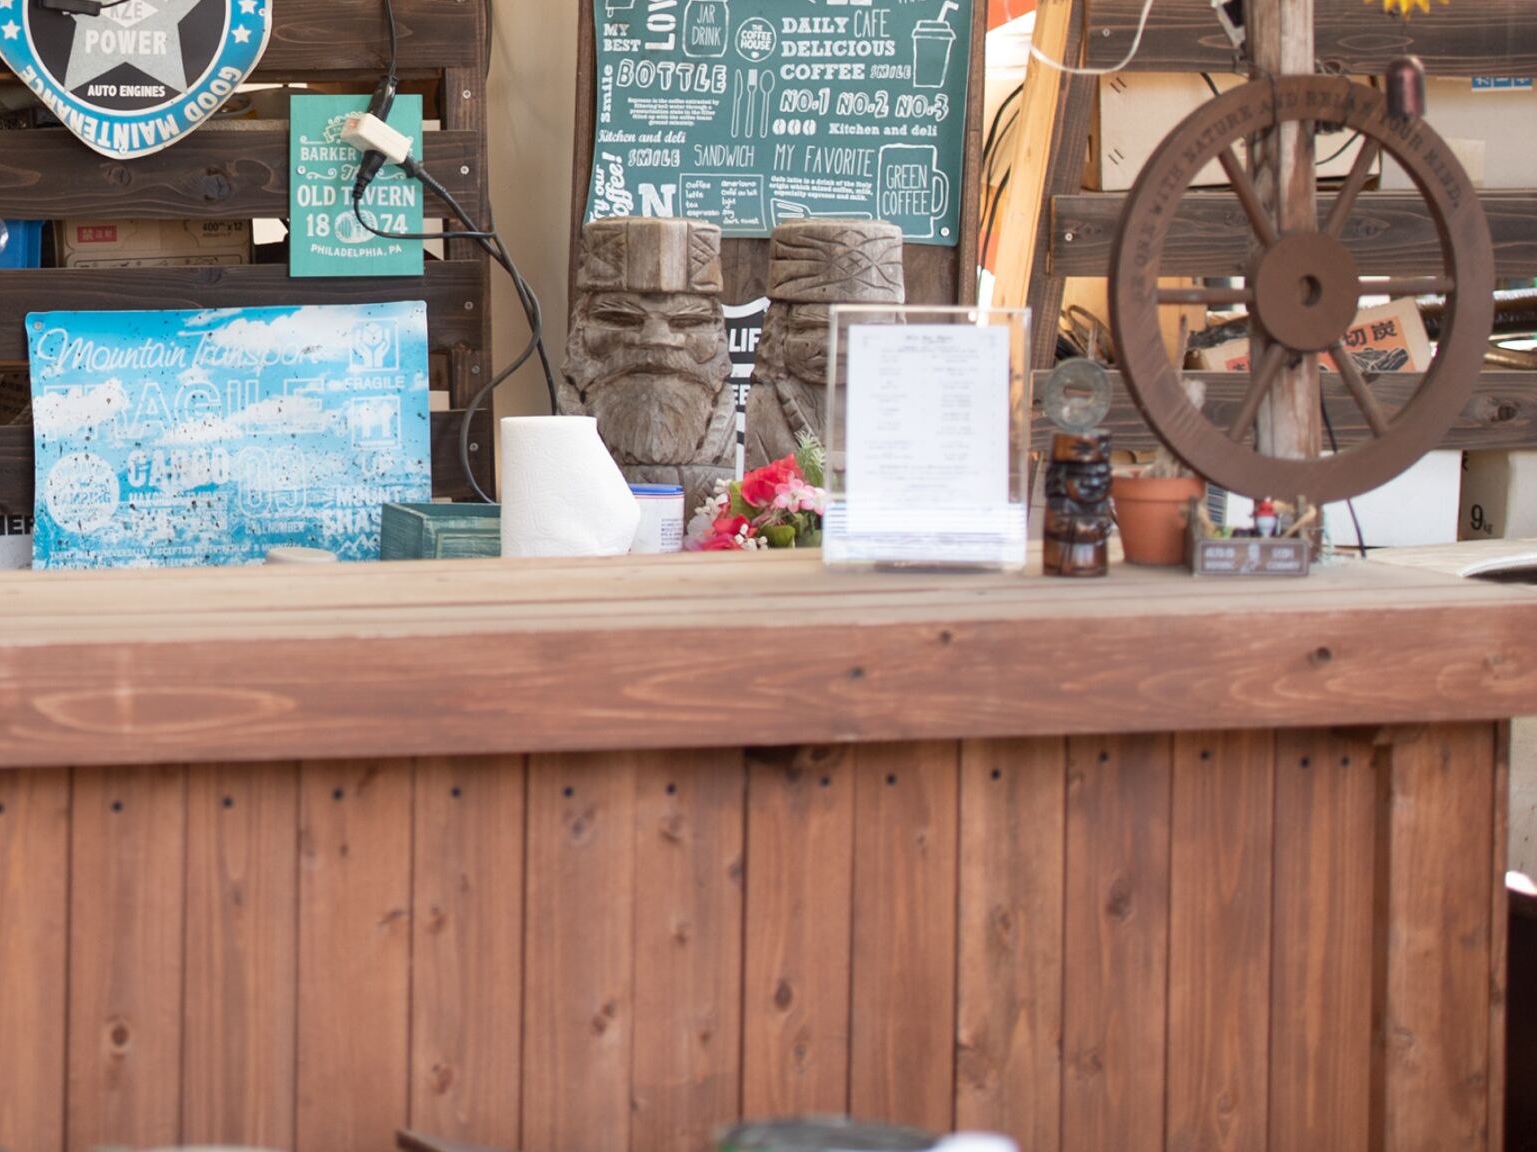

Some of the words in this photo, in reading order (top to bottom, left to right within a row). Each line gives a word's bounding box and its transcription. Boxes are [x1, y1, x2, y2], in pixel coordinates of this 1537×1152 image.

[696, 4, 716, 25] JAR
[781, 17, 849, 34] DAILY
[854, 9, 891, 38] CAFE
[603, 23, 630, 36] MY
[691, 26, 722, 47] DRINK
[740, 30, 772, 41] COFFEE
[84, 30, 167, 55] POWER
[603, 39, 641, 52] BEST
[740, 39, 772, 51] HOUSE
[781, 40, 895, 57] DELICIOUS
[616, 58, 727, 94] BOTTLE
[780, 64, 865, 80] COFFEE
[870, 65, 911, 79] SMILE
[87, 85, 118, 97] AUTO
[119, 85, 166, 97] ENGINES
[184, 66, 243, 122] GOOD
[22, 65, 181, 149] MAINTENANCE
[780, 88, 830, 116] NO.1
[836, 90, 889, 118] NO.2
[895, 94, 949, 121] NO.3
[598, 129, 636, 143] Kitchen
[638, 130, 662, 143] and
[664, 130, 686, 144] deli
[829, 123, 880, 135] Kitchen
[883, 124, 908, 136] and
[911, 124, 938, 136] deli
[1182, 104, 1254, 163] NATURE
[299, 147, 357, 161] BARKER
[628, 148, 680, 167] SMILE
[694, 144, 754, 167] SANDWICH
[773, 143, 796, 171] MY
[804, 145, 876, 178] FAVORITE
[341, 164, 360, 181] Th
[886, 165, 928, 189] GREEN
[297, 185, 336, 207] OLD
[882, 190, 931, 216] COFFEE
[306, 213, 331, 237] 18
[380, 214, 408, 235] 74
[389, 245, 402, 255] PA
[729, 328, 762, 353] LIF
[37, 328, 186, 373] Mountain
[177, 331, 320, 376] Transport
[345, 375, 406, 390] FRAGILE
[44, 378, 325, 442] FRAGILE
[128, 449, 230, 488] CARGO
[335, 485, 405, 505] MOUNT
[322, 508, 381, 536] SHAS
